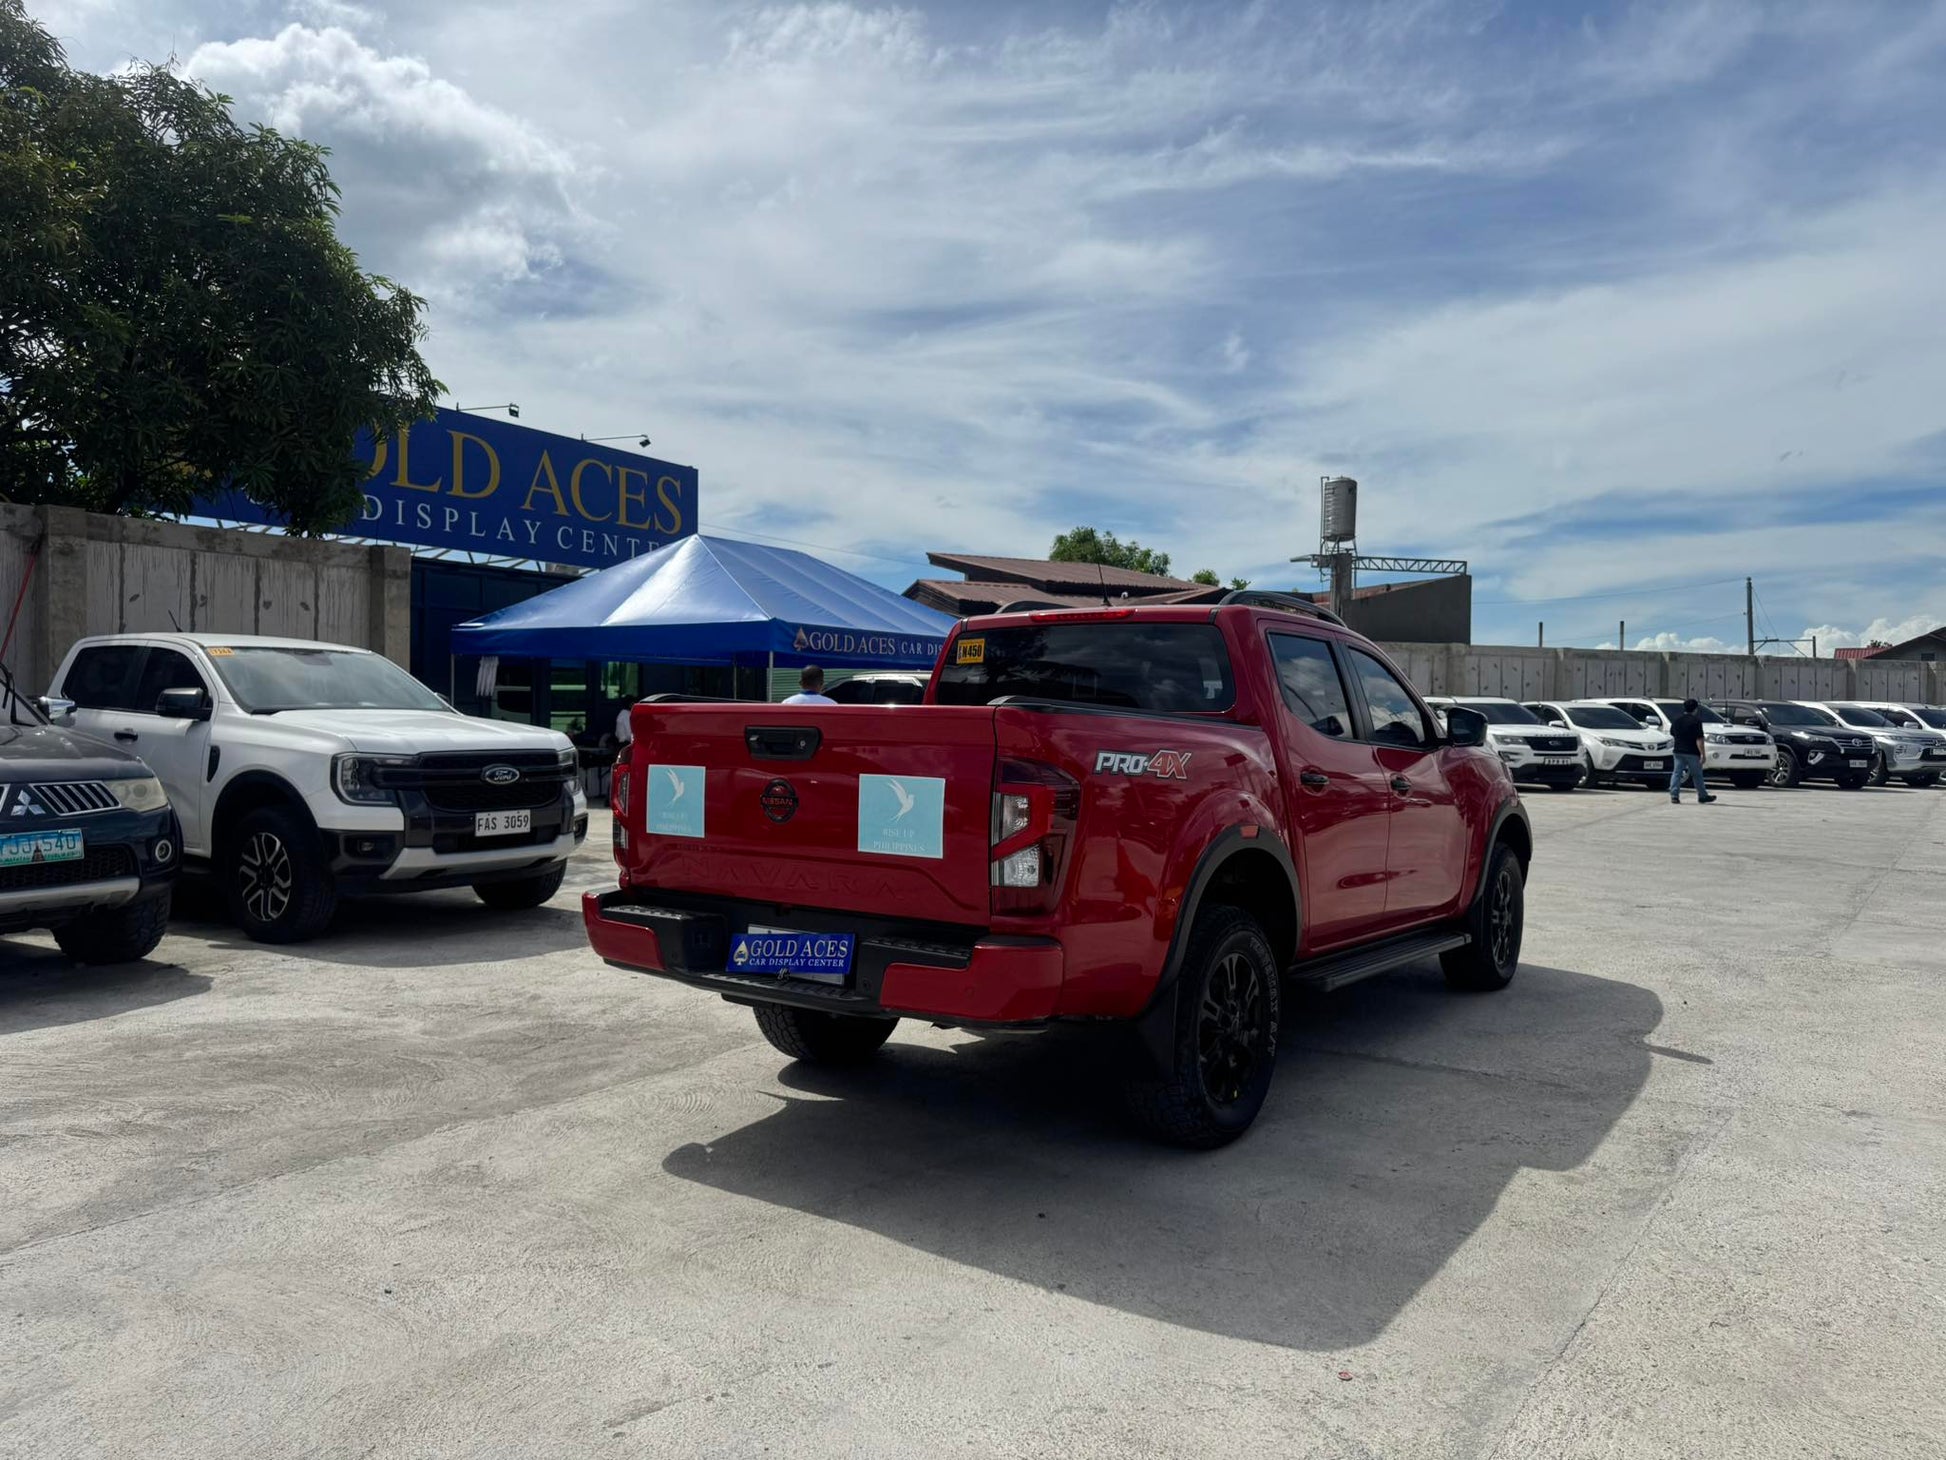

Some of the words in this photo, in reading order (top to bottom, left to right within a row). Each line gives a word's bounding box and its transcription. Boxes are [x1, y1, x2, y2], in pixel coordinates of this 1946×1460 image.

[520, 449, 683, 535] ACES
[360, 494, 541, 544] DISPLAY
[809, 631, 855, 653] GOLD
[857, 636, 896, 655] ACES
[901, 641, 923, 655] CAR
[477, 817, 497, 831] FAS
[503, 814, 529, 830] 3059
[681, 856, 899, 898] NAVARA
[750, 939, 798, 957] GOLD
[800, 939, 848, 958] ACES
[749, 958, 766, 966] CAR
[768, 958, 806, 967] DISPLAY
[807, 959, 845, 967] CENTER
